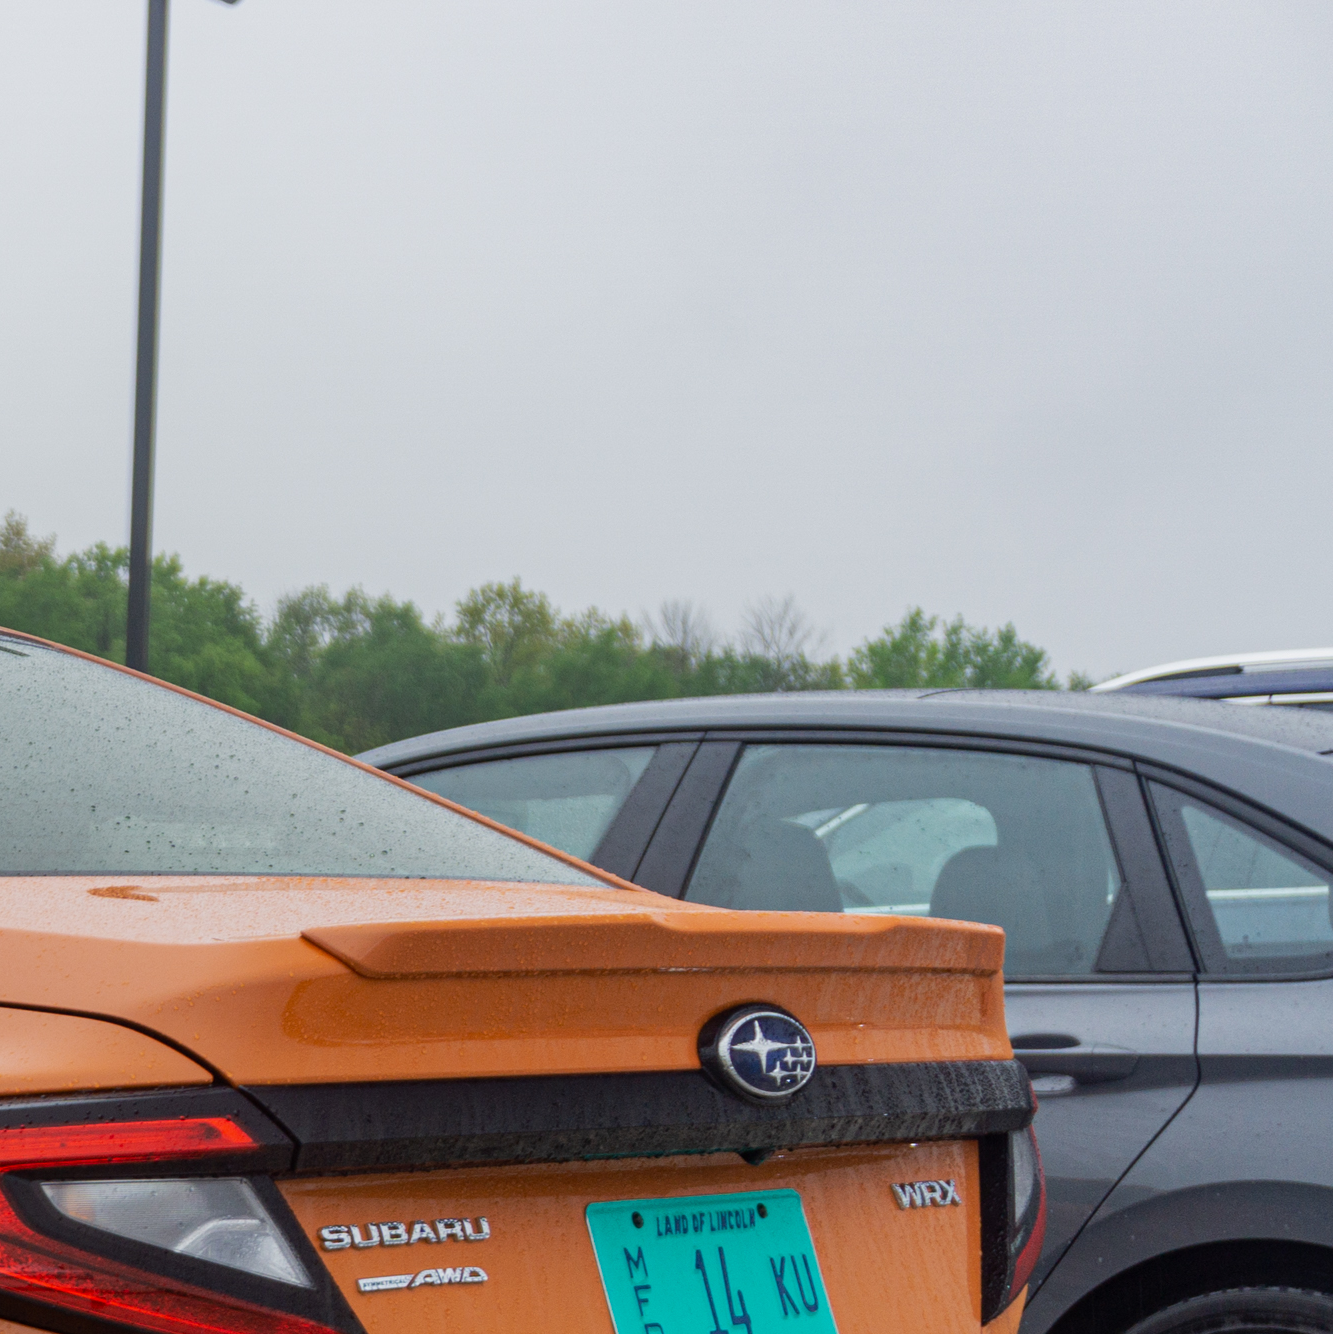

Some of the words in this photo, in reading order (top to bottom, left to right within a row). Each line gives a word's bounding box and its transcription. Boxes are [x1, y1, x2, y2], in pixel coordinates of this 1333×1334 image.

[890, 1179, 962, 1211] WRX
[319, 1215, 491, 1251] SUBARU
[656, 1213, 689, 1238] LAND
[692, 1211, 706, 1234] OF
[708, 1207, 757, 1233] LINCOLN
[410, 1266, 488, 1290] AWD
[768, 1253, 820, 1317] KU
